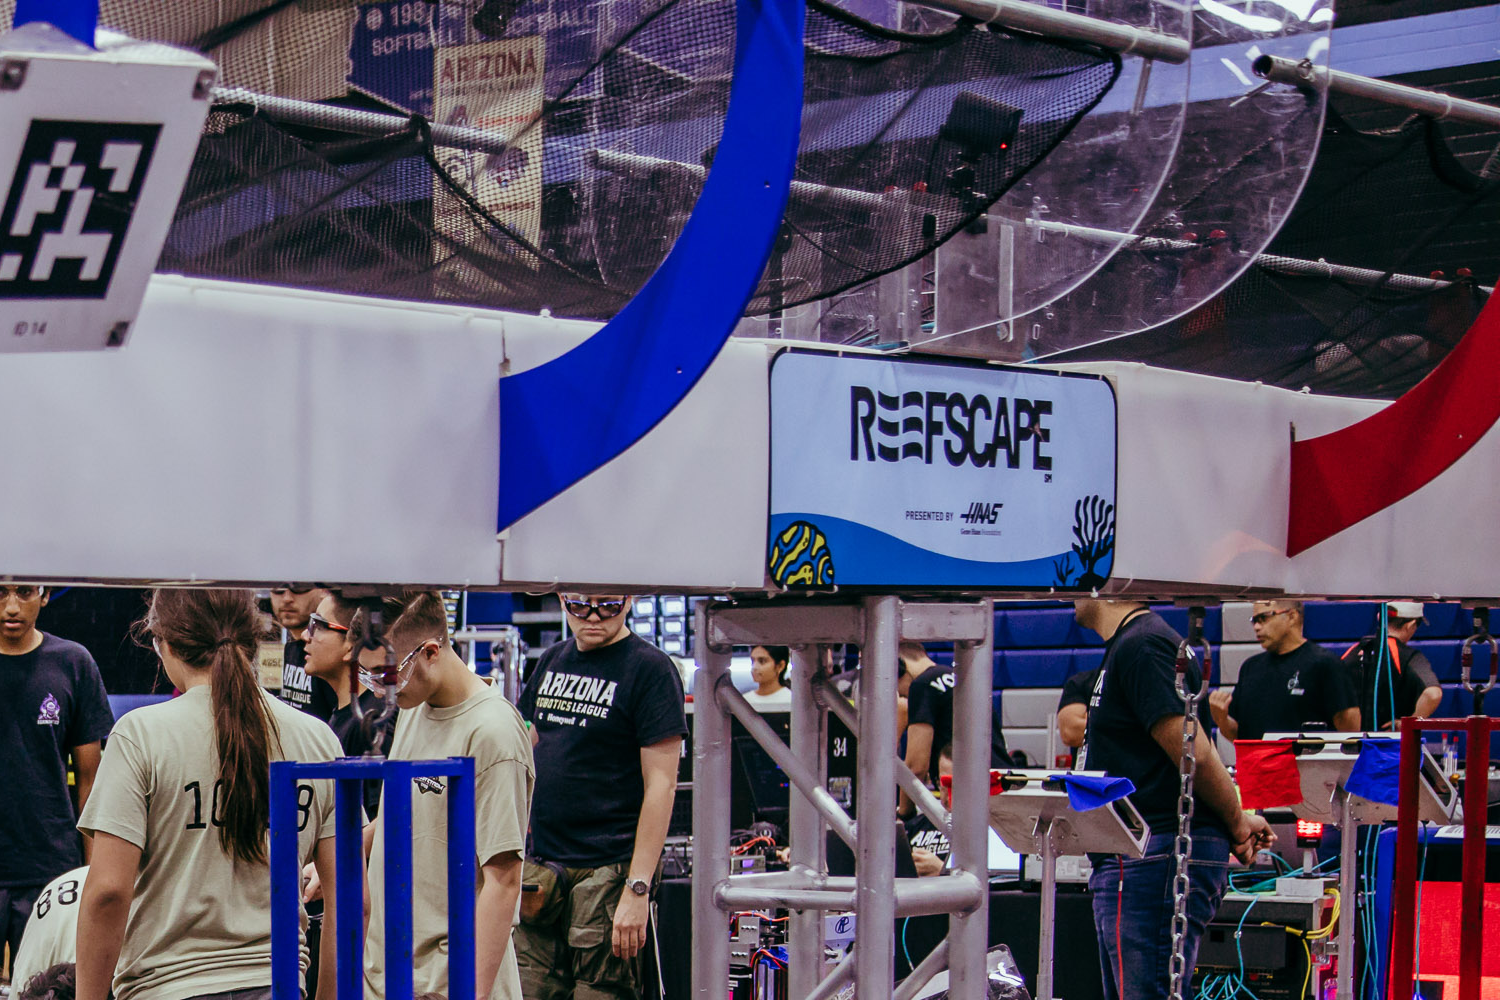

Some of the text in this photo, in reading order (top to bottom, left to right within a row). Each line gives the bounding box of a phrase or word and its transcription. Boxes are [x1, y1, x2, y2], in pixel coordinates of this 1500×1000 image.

[32, 321, 48, 336] 14
[850, 385, 1053, 471] REEFSCAPE
[905, 502, 1004, 524] PRESENTED BY HAAS
[538, 670, 618, 706] ARIZONA
[572, 702, 610, 719] LEAGUE
[833, 737, 847, 757] 34
